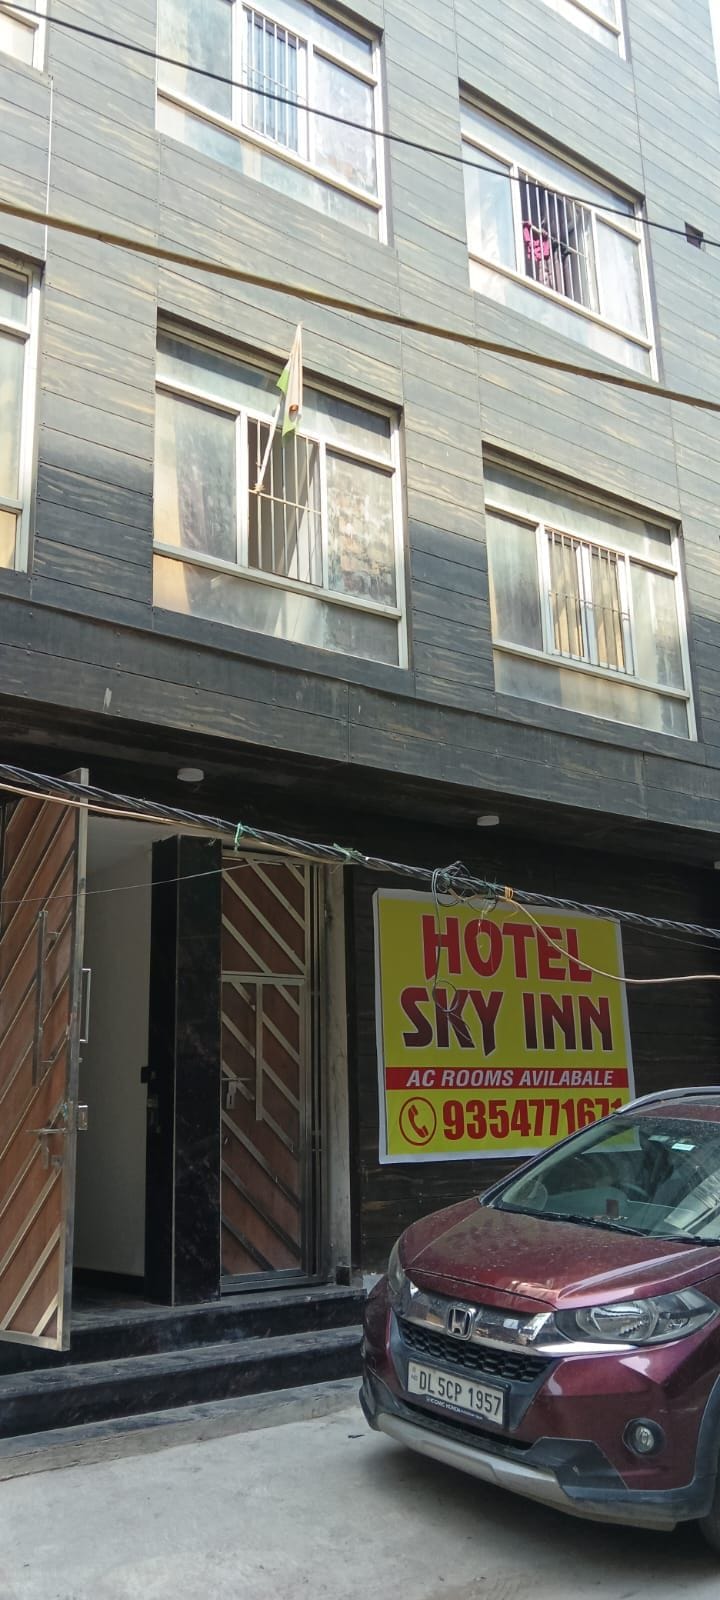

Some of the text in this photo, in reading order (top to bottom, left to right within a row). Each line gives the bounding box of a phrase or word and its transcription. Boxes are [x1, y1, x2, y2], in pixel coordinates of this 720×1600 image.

[421, 914, 593, 983] HOTEL
[400, 986, 614, 1057] SKY INN
[406, 1069, 614, 1087] AC ROOMS AVILABALE
[419, 1371, 502, 1416] DL 5CP 1957
